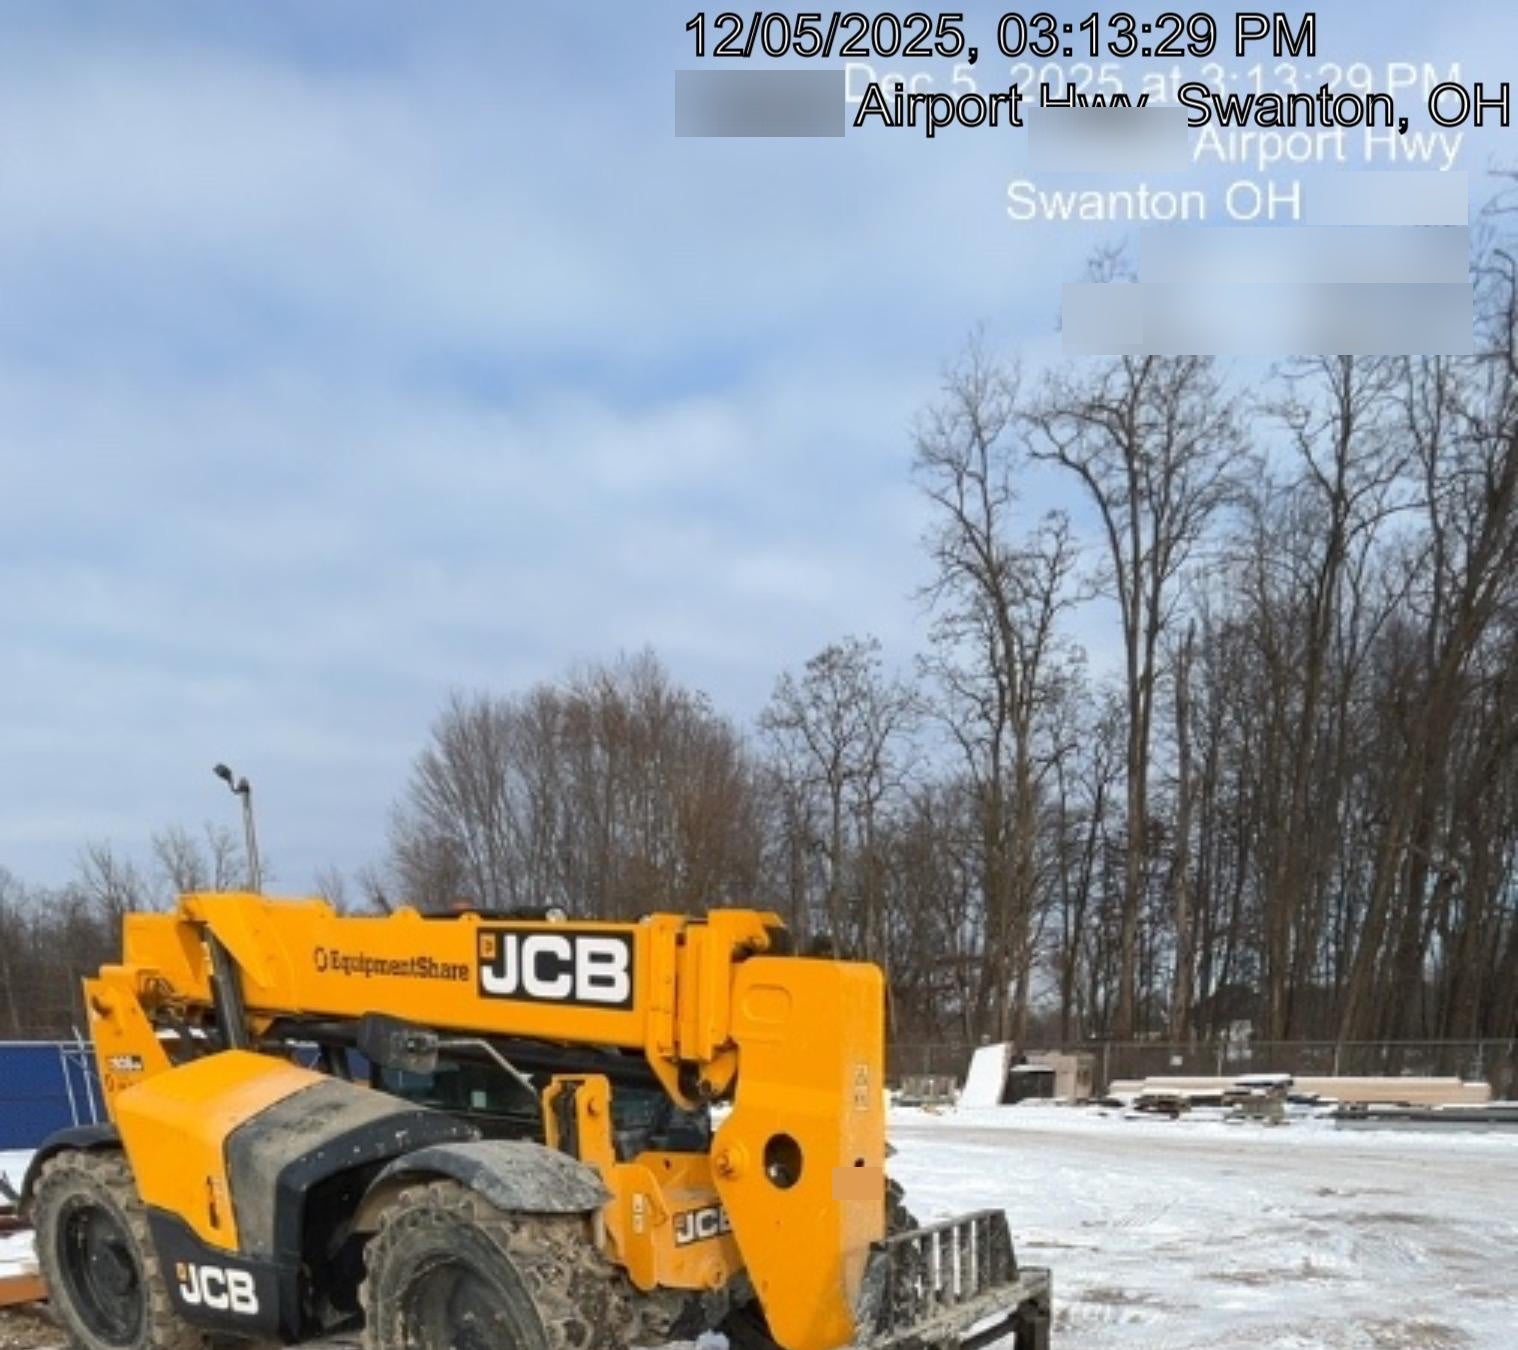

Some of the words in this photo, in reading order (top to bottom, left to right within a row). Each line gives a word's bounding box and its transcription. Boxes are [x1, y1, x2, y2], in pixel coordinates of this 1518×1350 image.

[330, 949, 469, 982] EquipmentShare
[480, 934, 630, 1003] JCB
[179, 1262, 259, 1315] JCB
